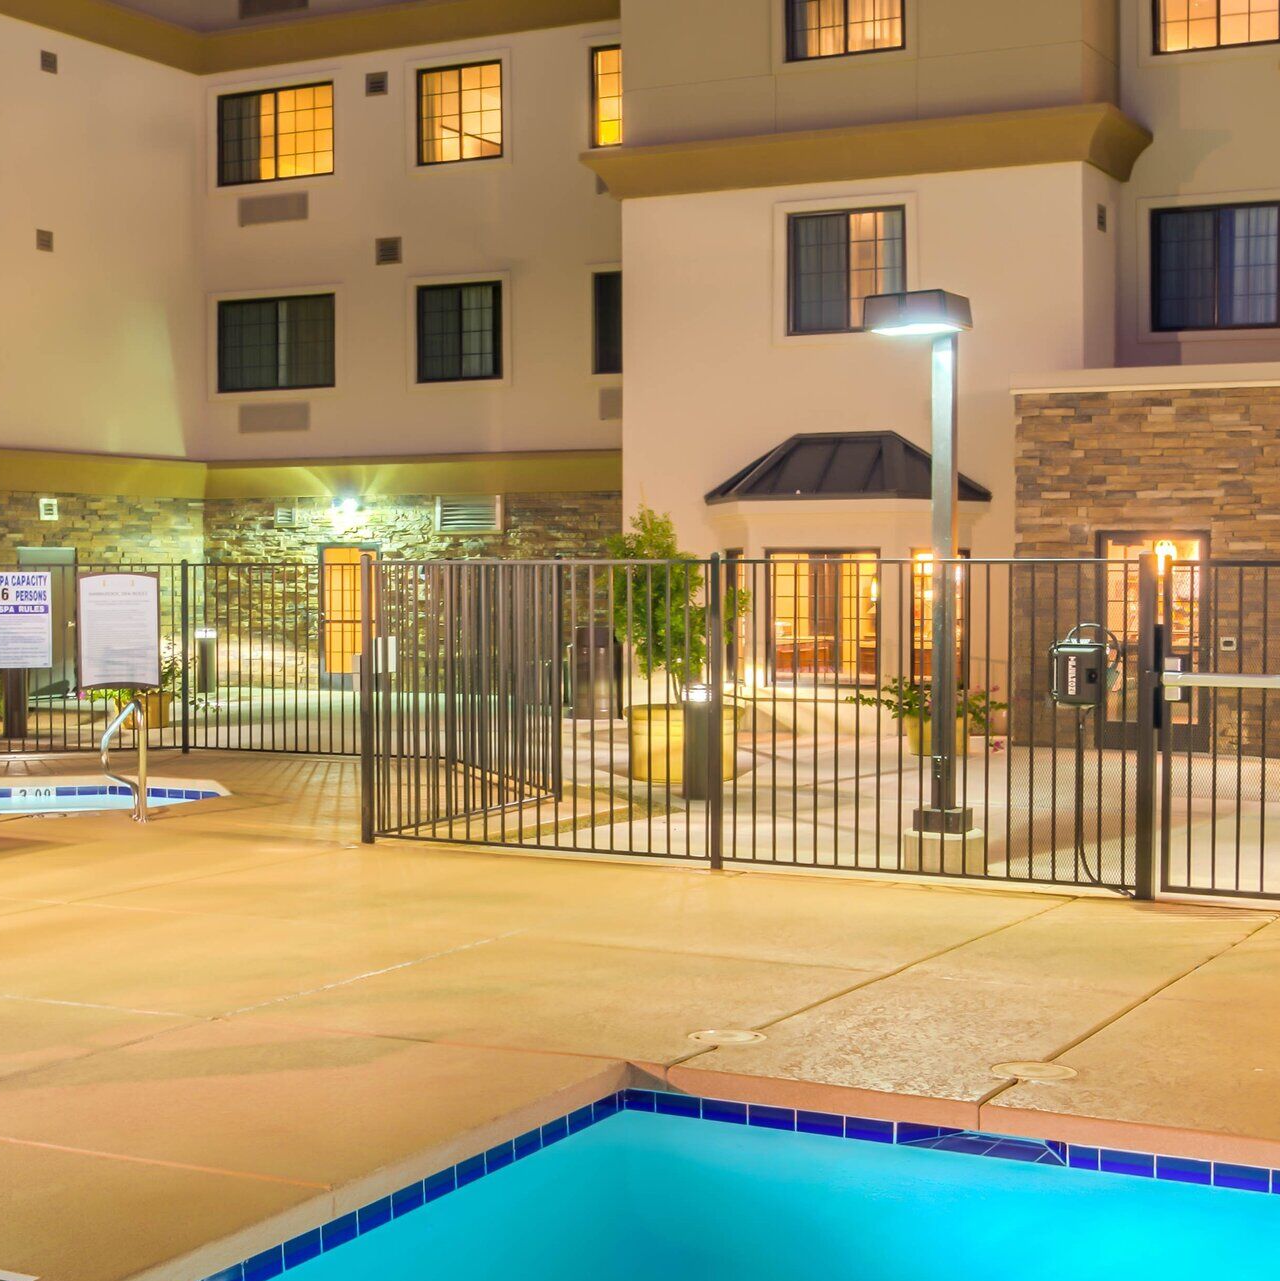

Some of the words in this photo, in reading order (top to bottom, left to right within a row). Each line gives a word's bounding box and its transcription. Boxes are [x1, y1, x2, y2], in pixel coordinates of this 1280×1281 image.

[11, 575, 47, 586] CAPACITY
[1, 588, 9, 600] 6
[15, 590, 47, 601] PERSONS
[18, 605, 45, 613] RULES
